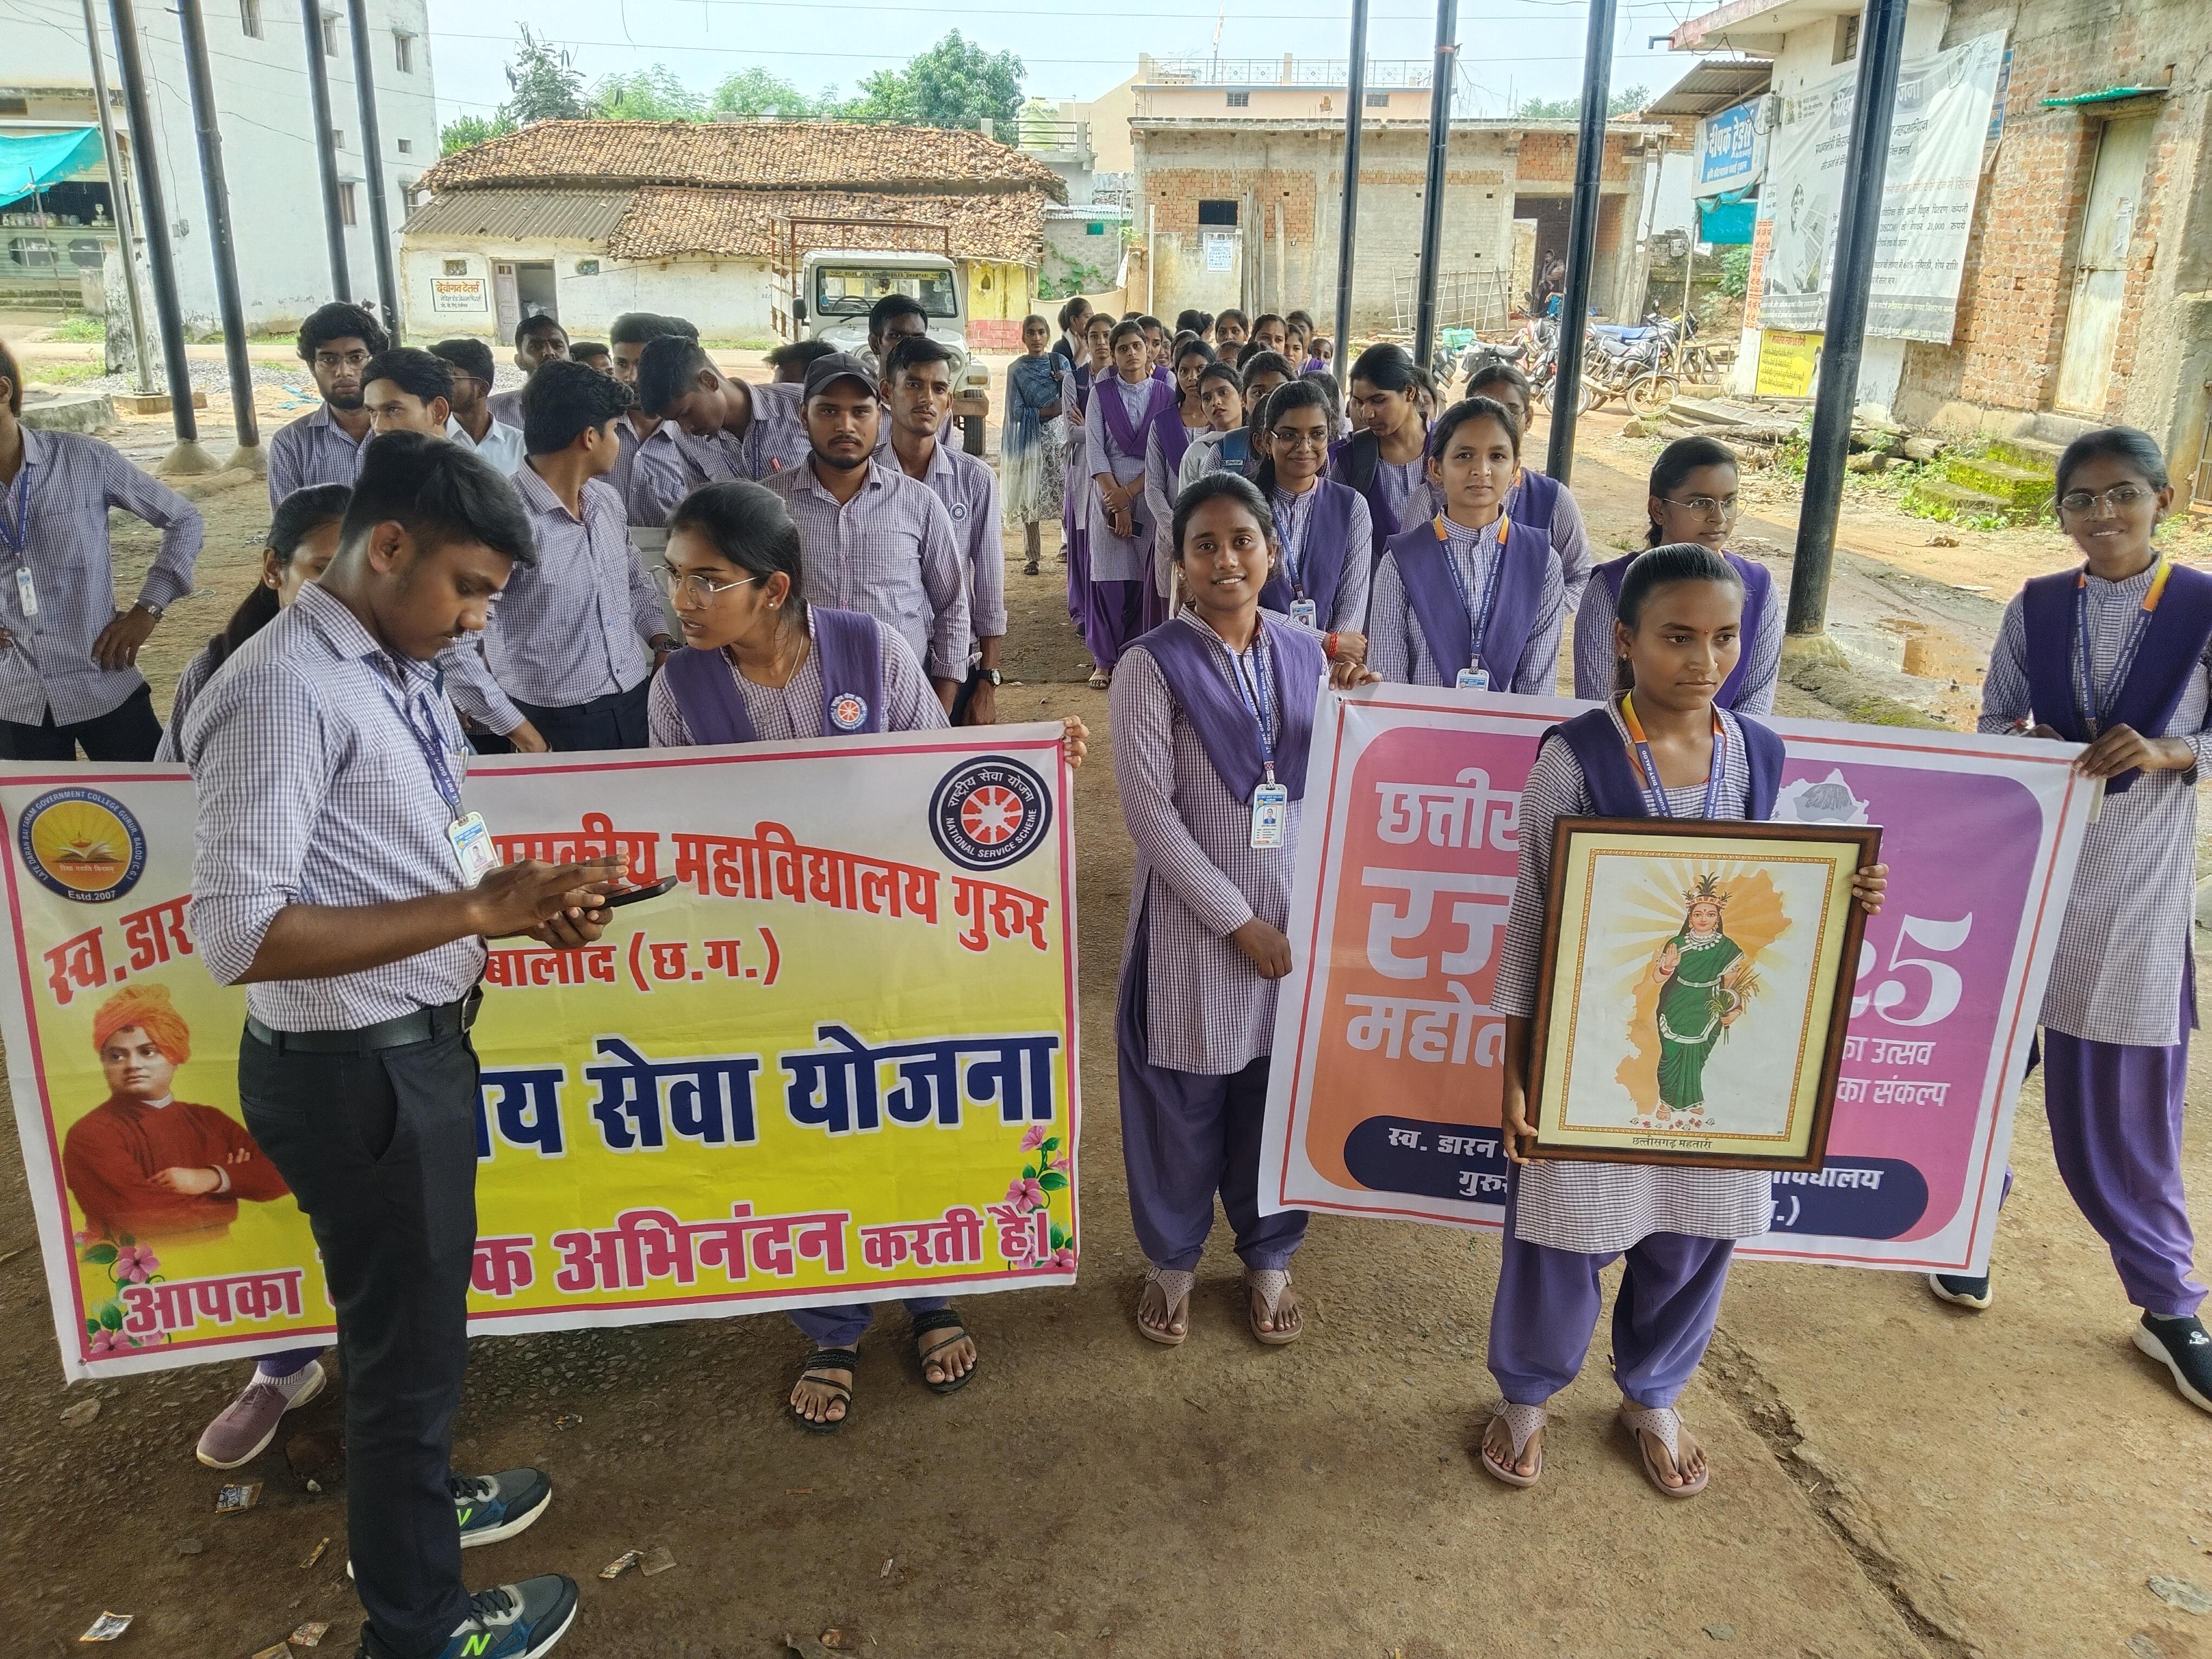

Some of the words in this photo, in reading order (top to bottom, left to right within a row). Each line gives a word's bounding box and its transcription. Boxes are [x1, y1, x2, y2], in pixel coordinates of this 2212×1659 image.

[1897, 79, 1921, 101] जना
[1708, 123, 1732, 158] दीपक
[1931, 203, 1948, 214] वितरण
[1951, 202, 1969, 214] कंपनी
[1951, 220, 1966, 230] रुपये
[1946, 260, 1958, 270] राशि
[436, 281, 461, 294] देवांगन
[461, 281, 480, 293] टेलर्स
[1483, 590, 1491, 614] COLLEGE
[1642, 750, 1658, 787] DIST-BALOD
[1714, 742, 1722, 779] DIST-BALOD
[35, 790, 86, 809] GOVERNMENT
[87, 792, 120, 812] COLLEGE
[947, 776, 976, 808] राष्ट्रीय
[978, 768, 1004, 782] सेवा
[1007, 774, 1035, 803] योजना
[1655, 787, 1666, 811] GURUR,
[23, 807, 37, 829] TARAM
[1375, 767, 1522, 852] छत्तीस
[133, 837, 143, 860] BALOD
[946, 816, 976, 857] NATIONAL
[977, 841, 1017, 859] SERVICE
[1014, 808, 1038, 844] SCHEME
[32, 864, 49, 882] LATE
[671, 821, 941, 925] महाविद्यालय
[68, 890, 116, 901] Estd.2007
[1361, 866, 1519, 980] रज
[43, 893, 194, 1006] स्व.डार
[628, 927, 780, 992] (छ.ग.)
[1345, 980, 1507, 1068] महोत्
[1870, 1038, 1937, 1066] उत्सव
[586, 1038, 760, 1149] सेवा
[782, 1025, 1059, 1134] योजना
[1837, 1077, 1871, 1103] का
[1873, 1075, 1952, 1107] संकल्प
[1388, 1127, 1427, 1152] स्व.
[1437, 1134, 1499, 1159] डारन
[1632, 1135, 1677, 1149] छत्तीसगढ़
[1678, 1138, 1713, 1150] महतारी
[555, 1204, 850, 1291] अभिनंदन
[864, 1210, 984, 1269] करती
[123, 1269, 303, 1334] आपका
